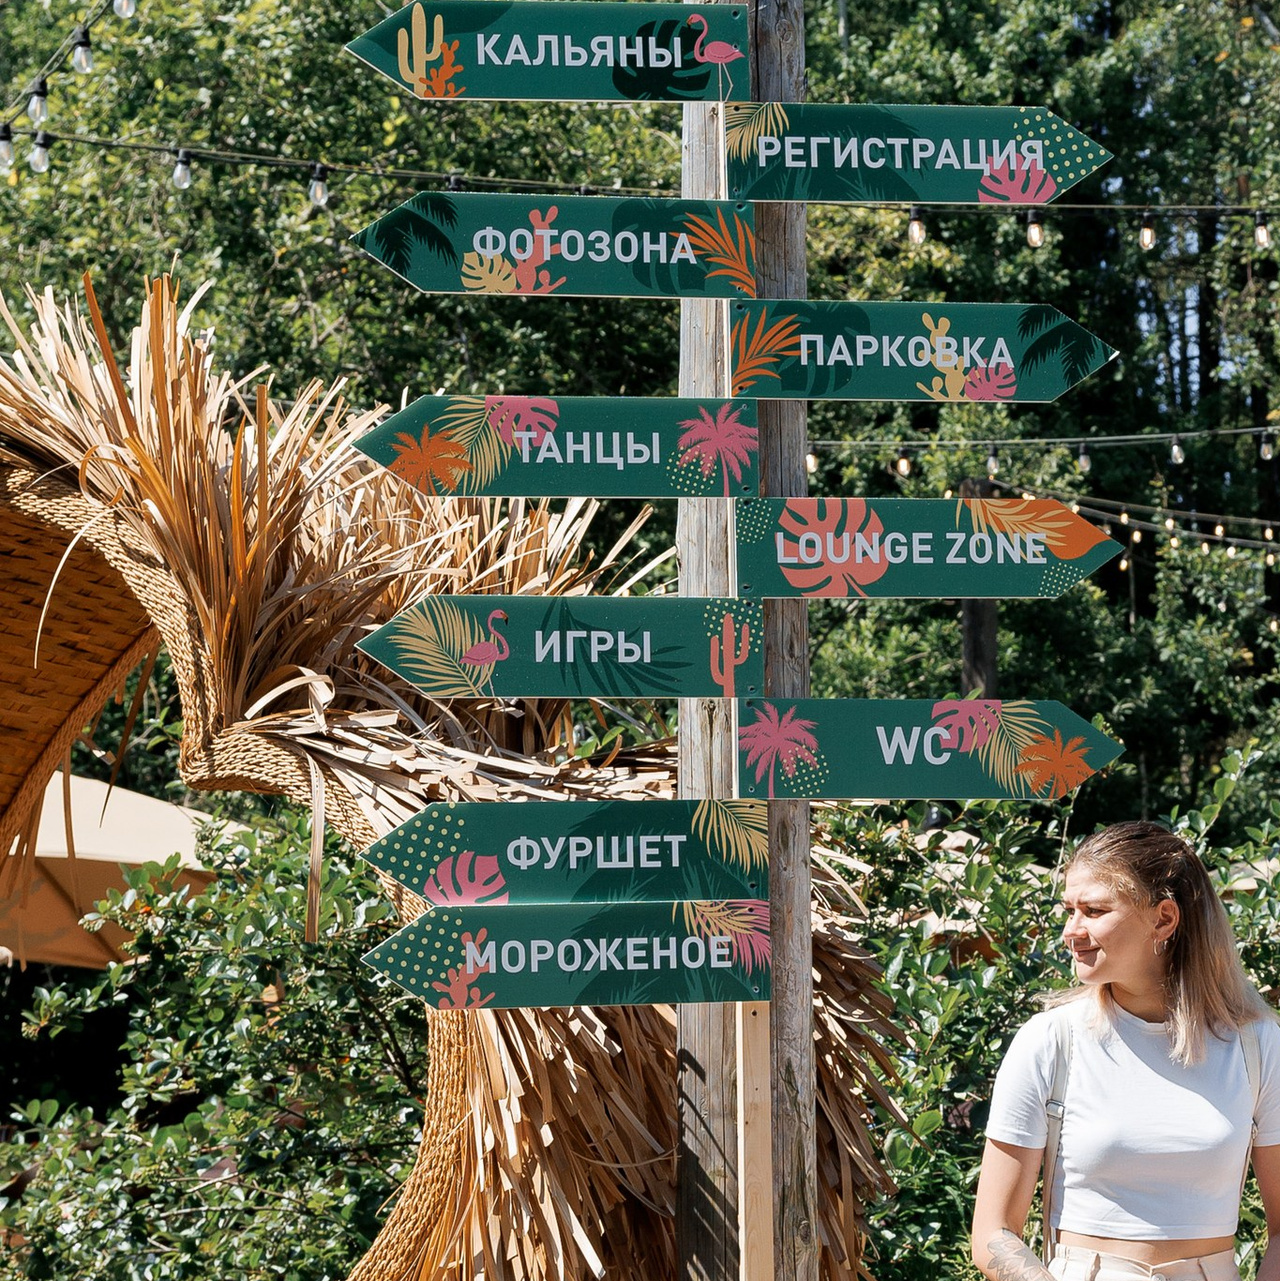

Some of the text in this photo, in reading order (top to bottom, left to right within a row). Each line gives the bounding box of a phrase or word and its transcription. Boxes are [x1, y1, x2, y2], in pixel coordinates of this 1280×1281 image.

[478, 34, 681, 67] КАЛЬЯНЫ
[757, 137, 1043, 176] РЕГИСТРАЦИЯ
[474, 227, 696, 263] ФОТОЗОНА
[801, 335, 1014, 369] ПАРКОВКА
[514, 432, 659, 469] ТАНЦЫ
[777, 531, 1046, 563] LOUNGE ZONE
[536, 631, 650, 662] ИГРЫ
[876, 727, 950, 764] WC
[507, 836, 686, 869] ФУРШЕТ
[466, 934, 732, 973] МОРОЖЕНОЕ
